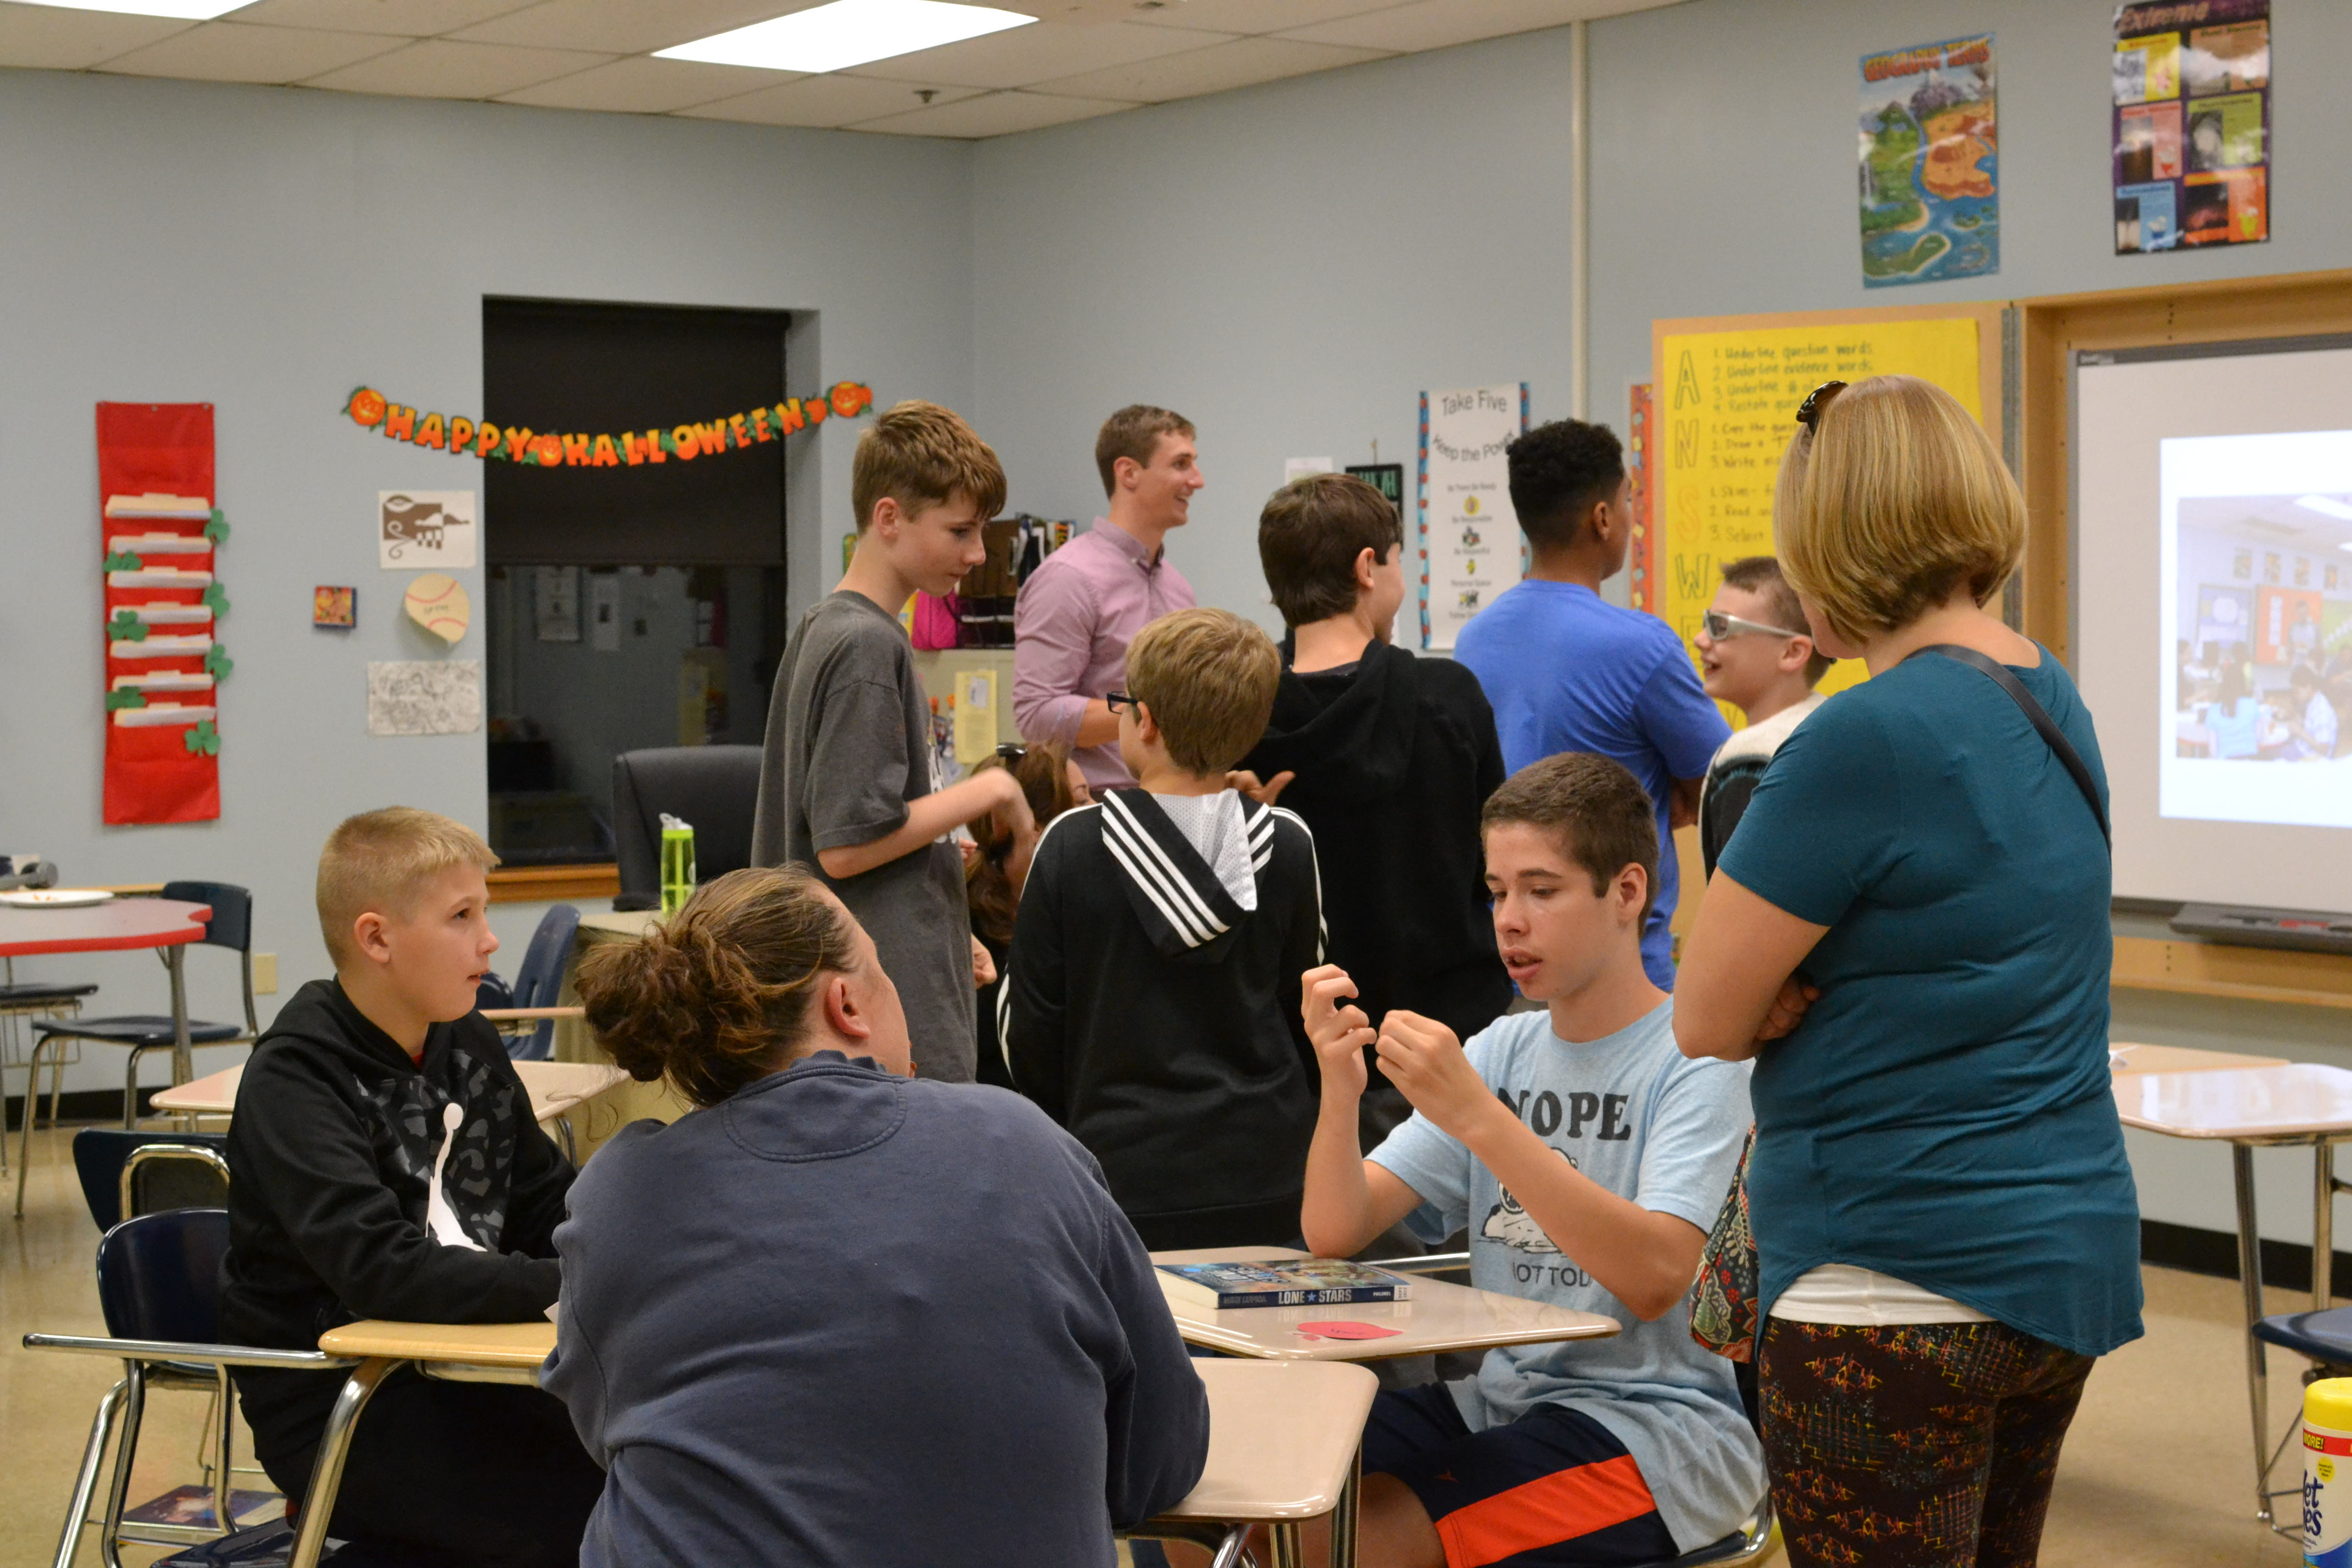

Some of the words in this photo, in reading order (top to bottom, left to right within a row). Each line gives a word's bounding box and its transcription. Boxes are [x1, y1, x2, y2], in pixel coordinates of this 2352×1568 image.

[1725, 345, 1775, 359] Underline
[1727, 362, 1778, 378] Underline
[1674, 350, 1701, 410] A
[1442, 393, 1474, 416] Take
[1478, 389, 1507, 412] Five
[385, 403, 533, 462] HAPPY
[561, 397, 805, 467] HALLOWEEN
[1675, 418, 1699, 470] N
[1461, 447, 1480, 462] the
[1675, 553, 1709, 600] W
[1498, 1088, 1631, 1141] NOPE
[1278, 1290, 1305, 1305] LONE
[1318, 1289, 1352, 1303] STARS
